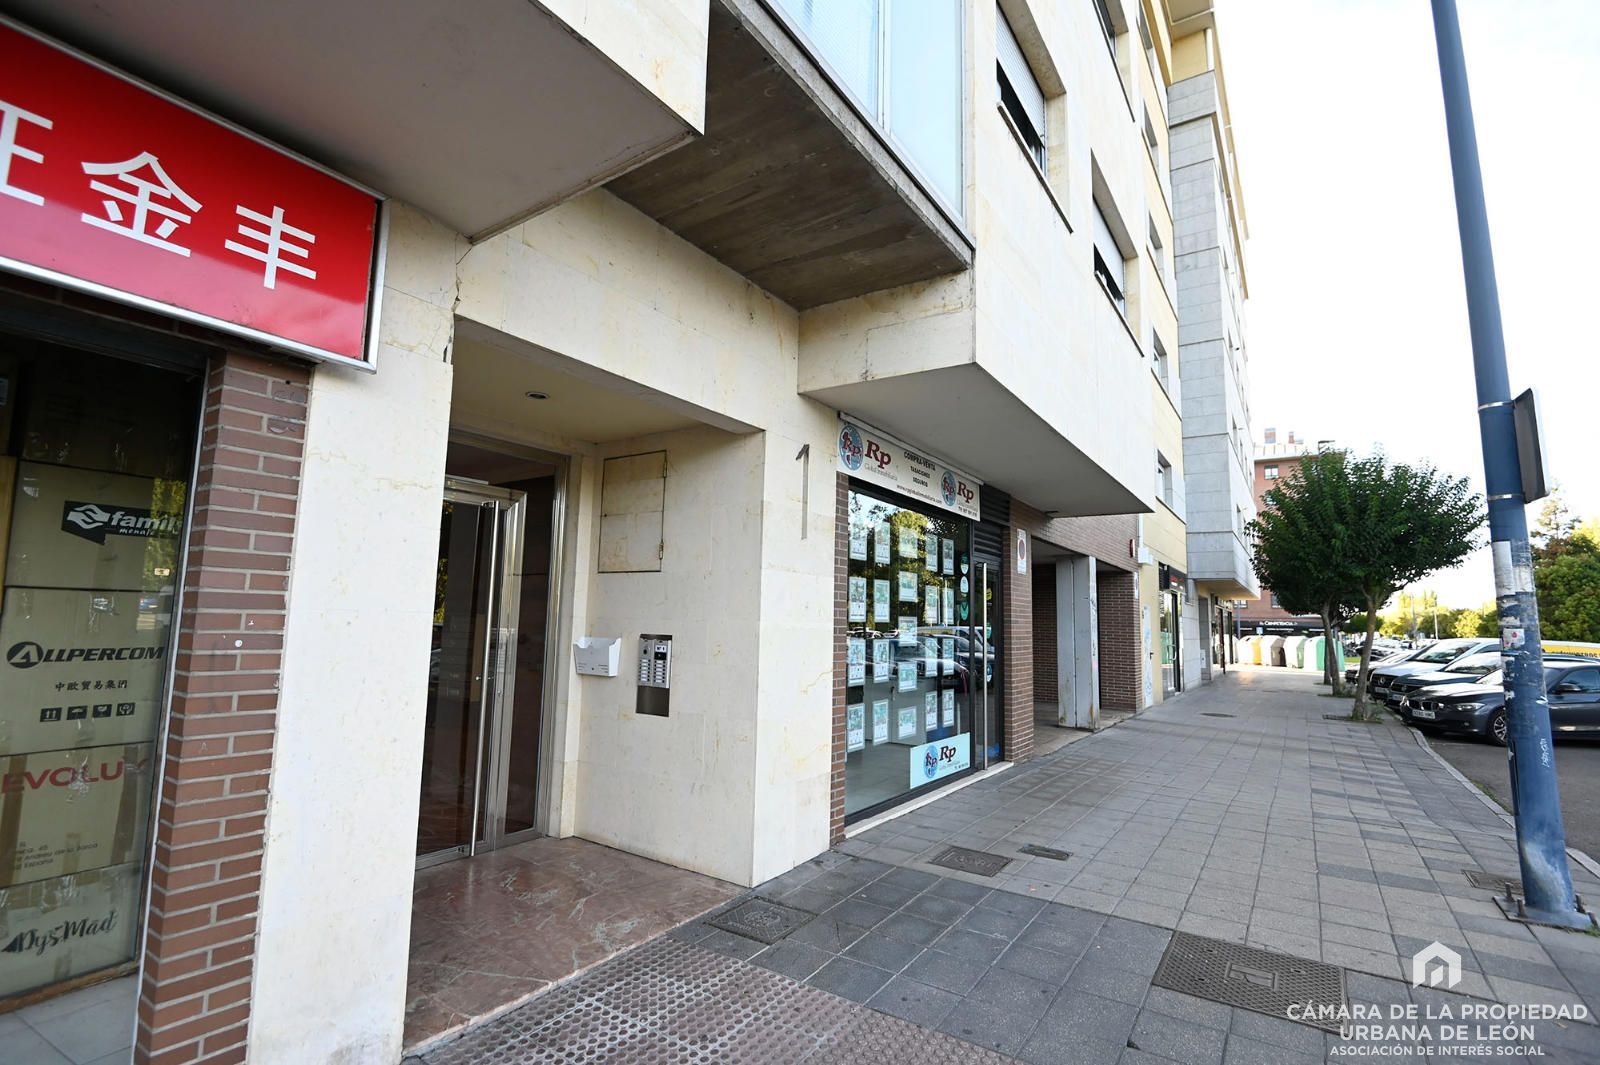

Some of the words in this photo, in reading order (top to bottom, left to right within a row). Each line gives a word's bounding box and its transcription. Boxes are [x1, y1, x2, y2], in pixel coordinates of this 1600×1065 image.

[865, 440, 892, 470] Rp
[903, 451, 936, 471] COMPRA-VENTA
[796, 444, 810, 540] 1
[957, 481, 974, 503] Rp
[7, 641, 164, 669] ALLPERCOM
[939, 746, 956, 763] Rp
